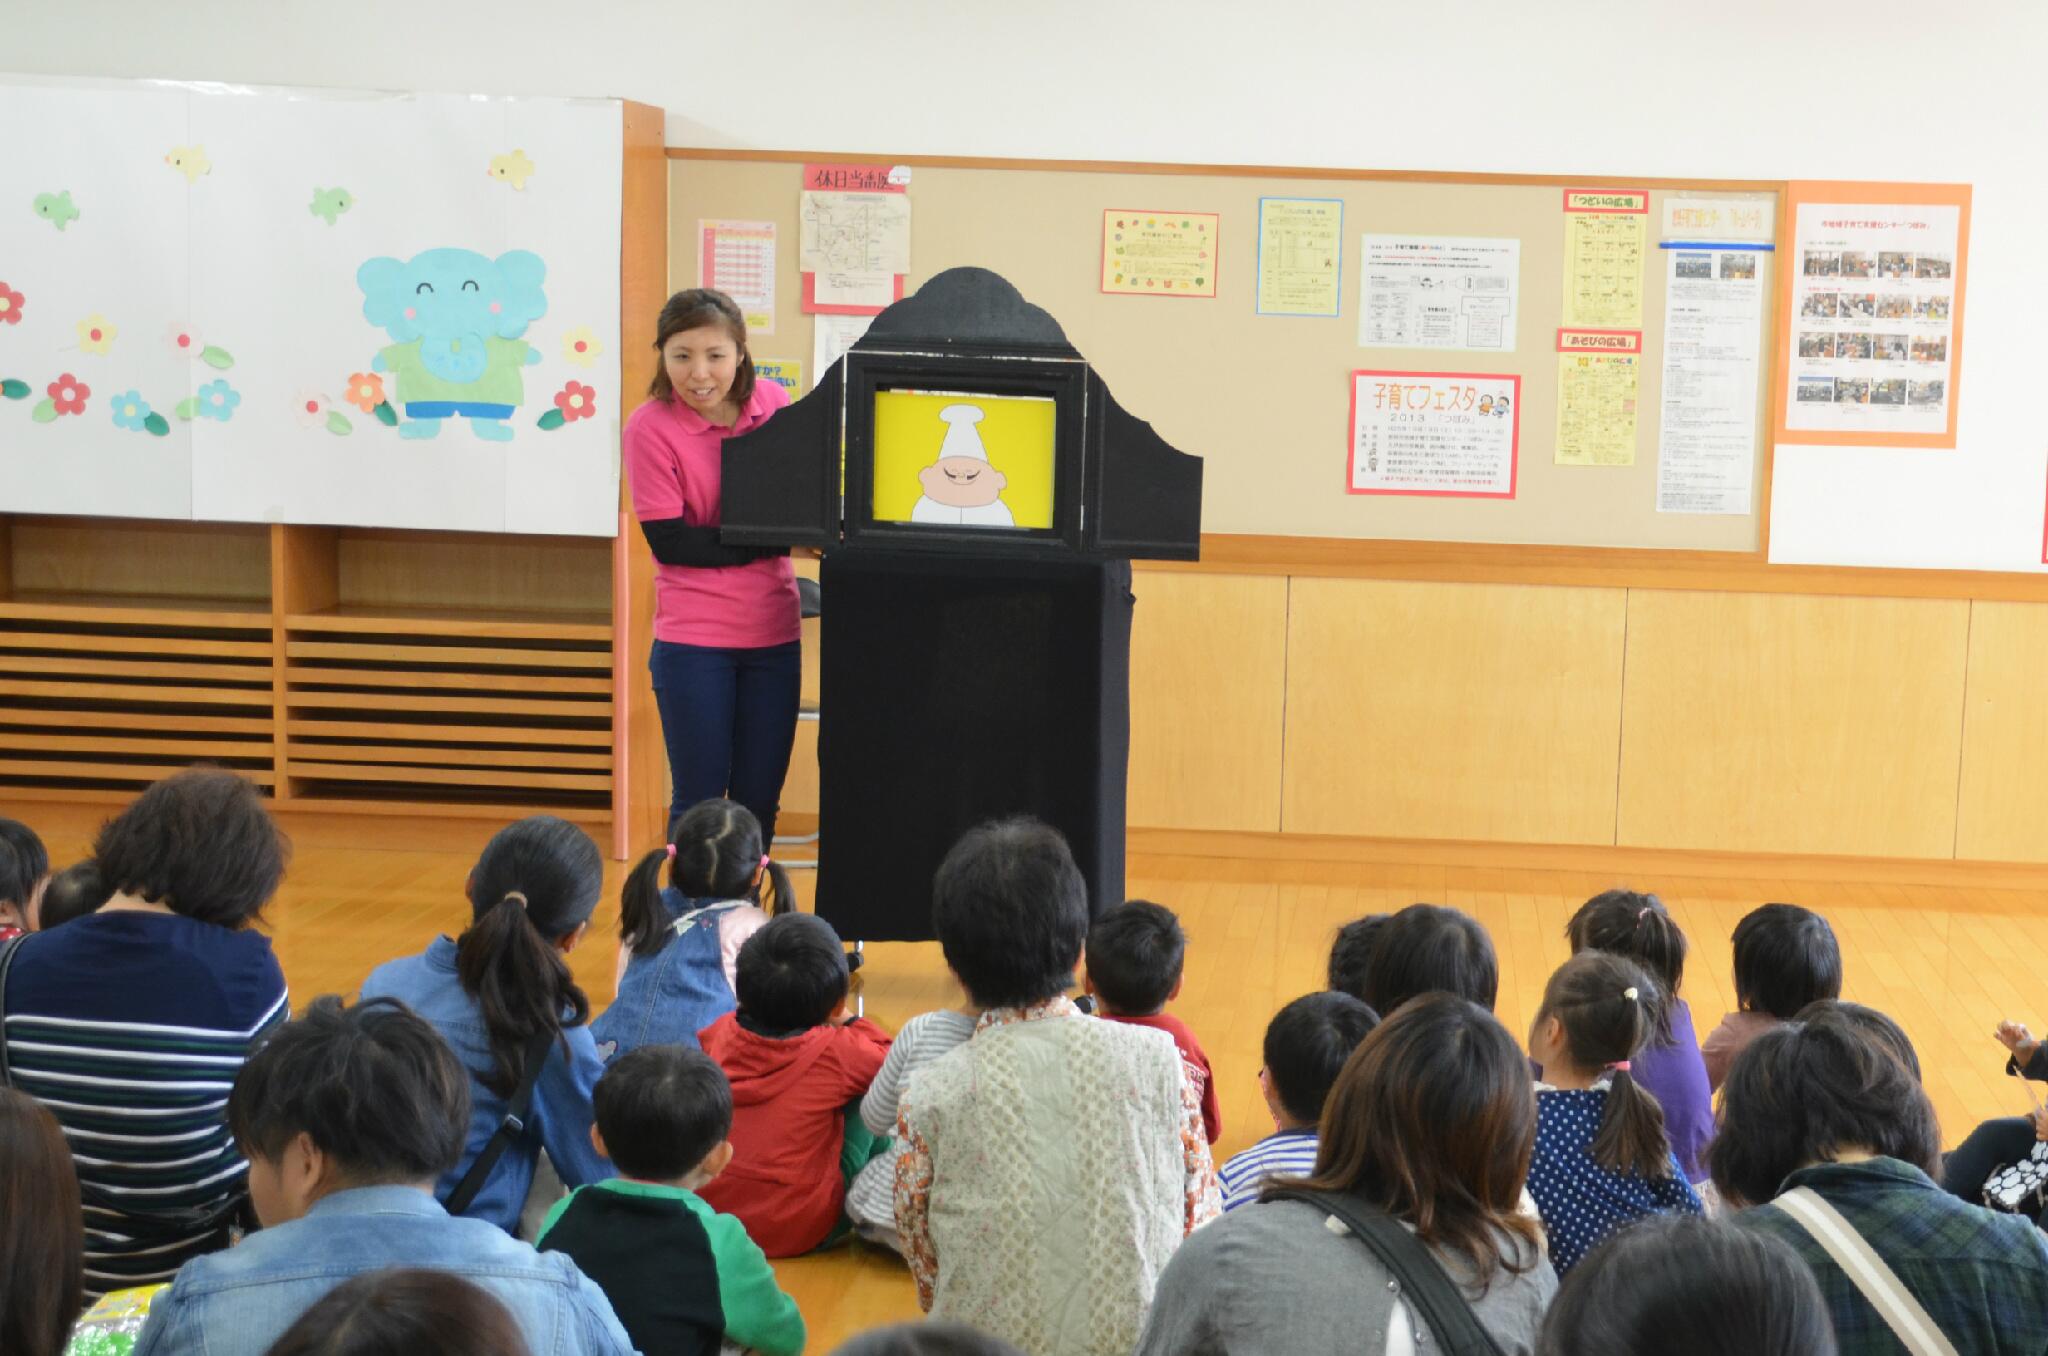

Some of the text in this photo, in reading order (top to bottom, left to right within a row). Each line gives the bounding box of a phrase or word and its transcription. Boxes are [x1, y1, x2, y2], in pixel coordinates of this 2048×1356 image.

[1573, 195, 1639, 209] 「つどいの広場」
[1566, 335, 1632, 348] 「あそびの広場」
[1373, 383, 1479, 412] 子育てフェスタ
